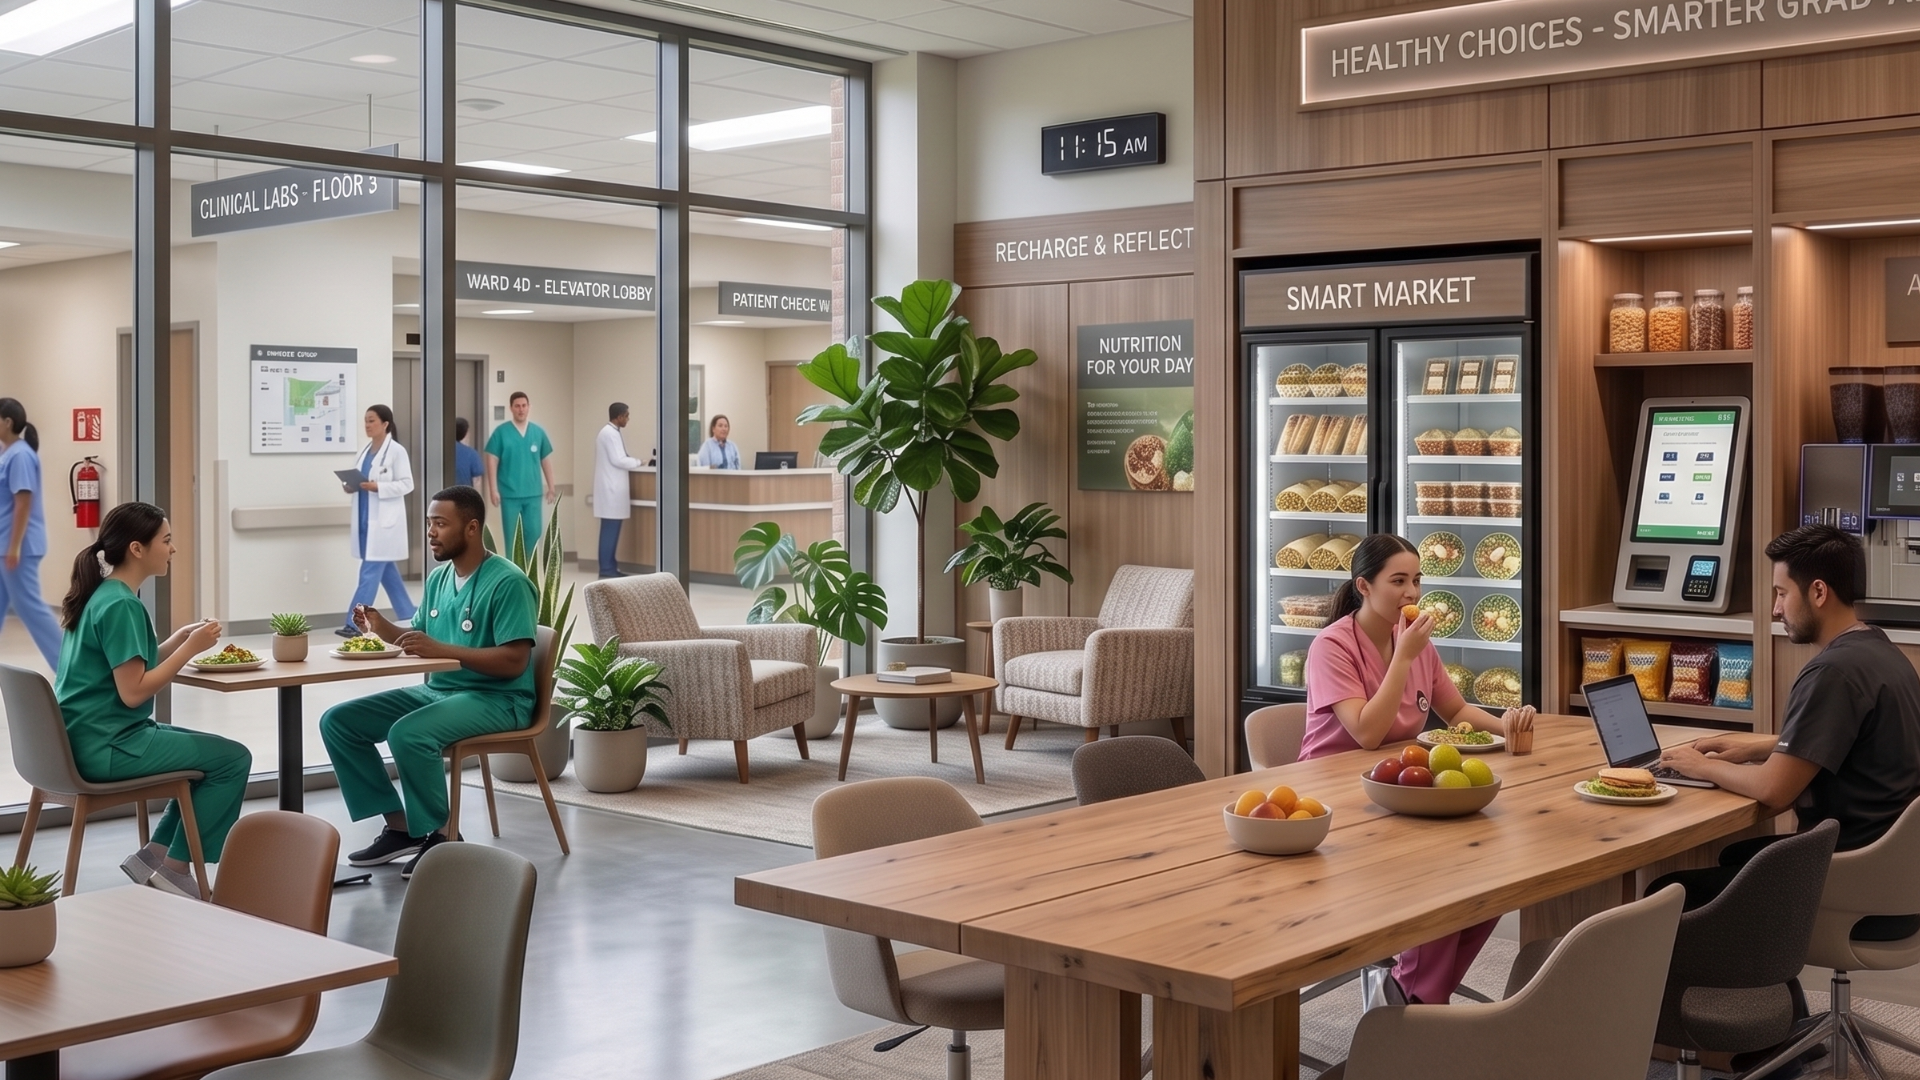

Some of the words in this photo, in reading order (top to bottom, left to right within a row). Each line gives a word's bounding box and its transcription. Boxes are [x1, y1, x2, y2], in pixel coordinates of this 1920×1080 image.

[1332, 33, 1451, 78] HEALTHY
[1458, 16, 1583, 60] CHOICES
[1613, 0, 1766, 40] SMARTER
[1060, 127, 1117, 161] 11:15
[1123, 135, 1147, 155] AM
[200, 190, 260, 220] CLINICAL
[264, 183, 299, 211] LABS
[313, 173, 363, 203] FLOOR
[369, 175, 378, 194] 3
[996, 236, 1089, 263] RECHARGE
[1094, 234, 1107, 256] &
[1114, 227, 1195, 254] REFLECT
[467, 273, 510, 291] WARD
[513, 277, 531, 292] 4D
[544, 279, 611, 299] ELEVATOR
[613, 284, 653, 301] LOBBY
[733, 292, 779, 309] PATIENT
[781, 295, 817, 312] CHECE
[1287, 283, 1367, 311] SMART
[1373, 276, 1476, 308] MARKET
[1100, 334, 1182, 354] NUTRITION
[1087, 359, 1116, 375] FOR
[1119, 357, 1161, 375] YOUR
[1164, 356, 1194, 374] DAY
